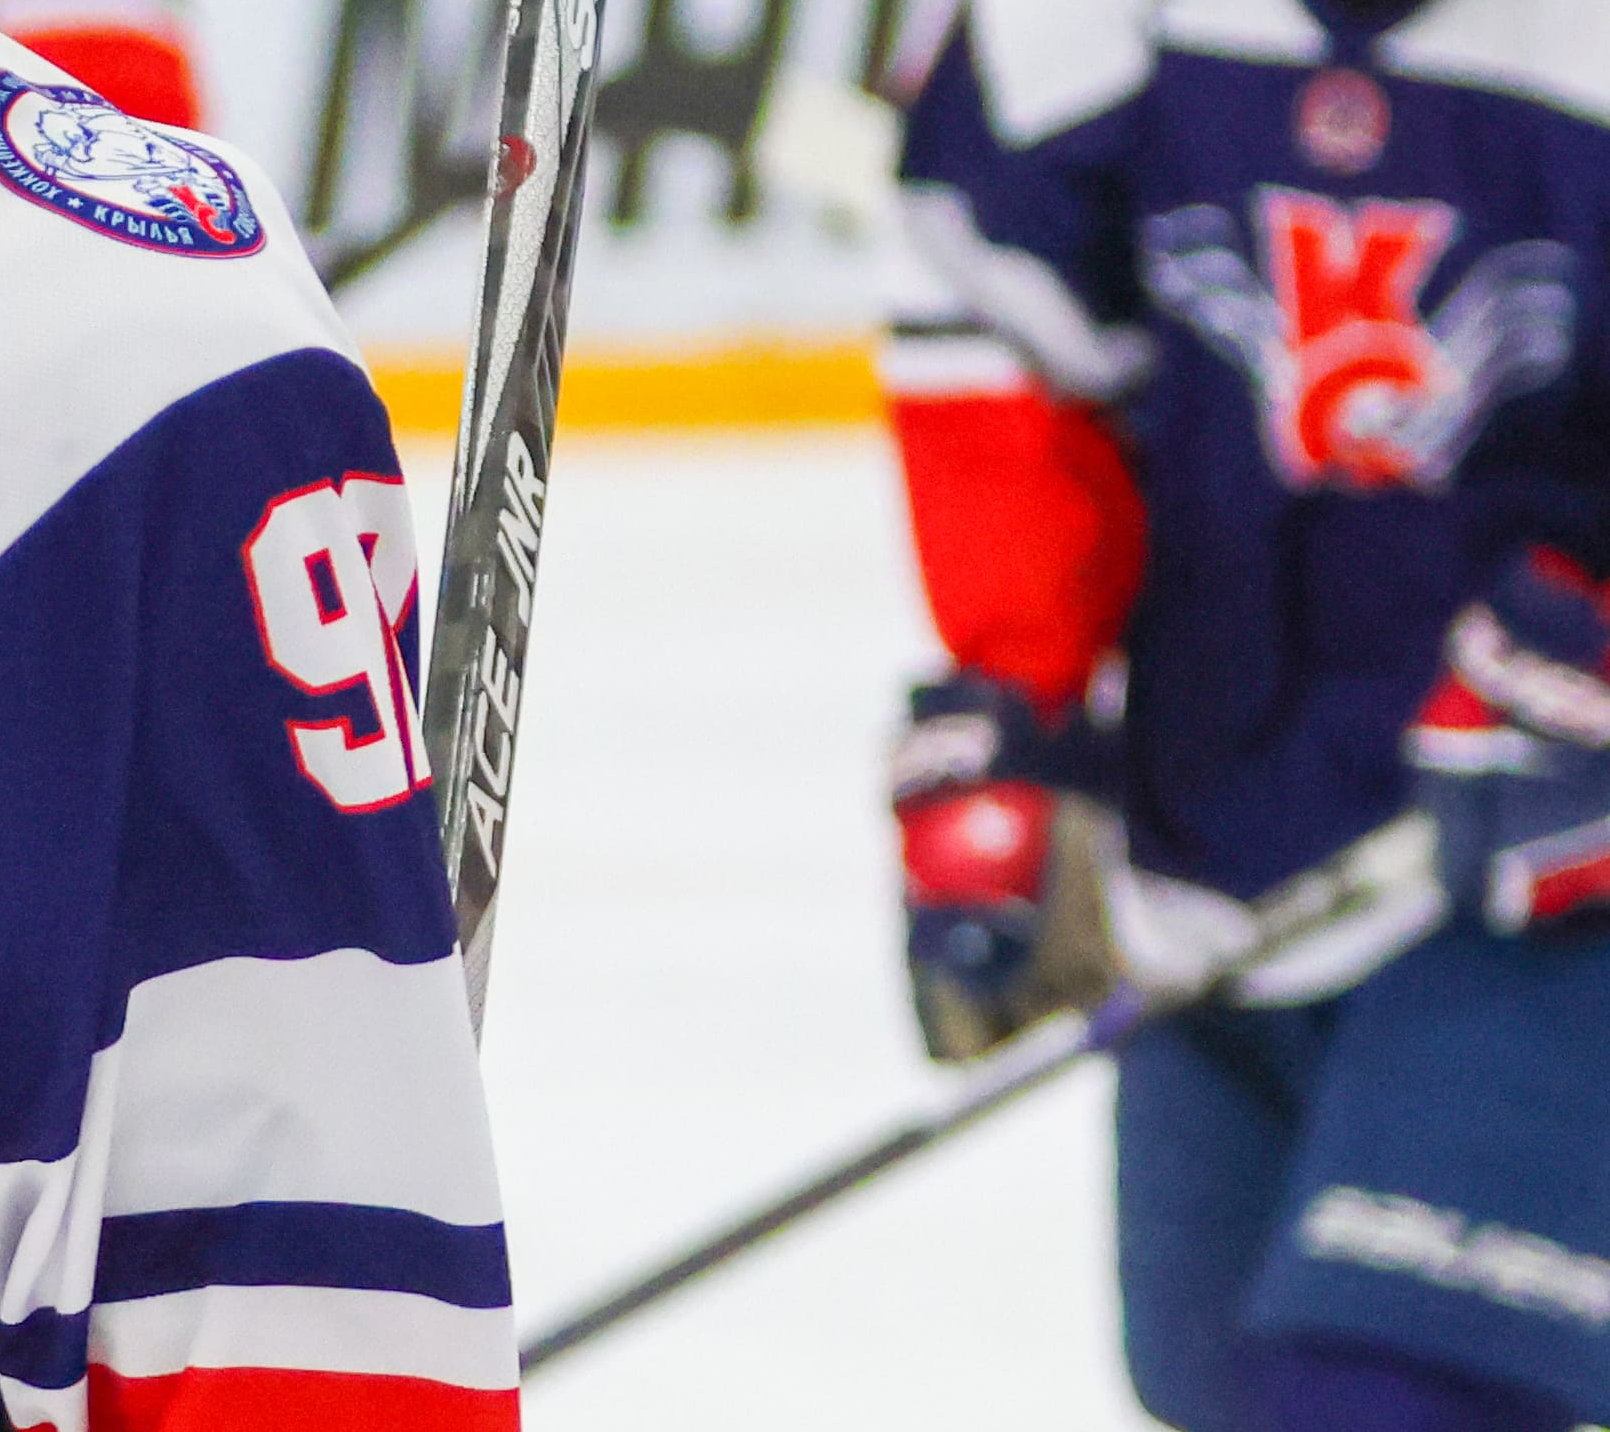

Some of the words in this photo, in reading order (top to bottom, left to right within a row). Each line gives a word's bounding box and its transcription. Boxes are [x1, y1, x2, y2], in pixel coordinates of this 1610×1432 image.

[94, 205, 194, 245] КРЫЛЬЯ
[468, 626, 519, 878] ACE
[497, 431, 546, 622] JNR
